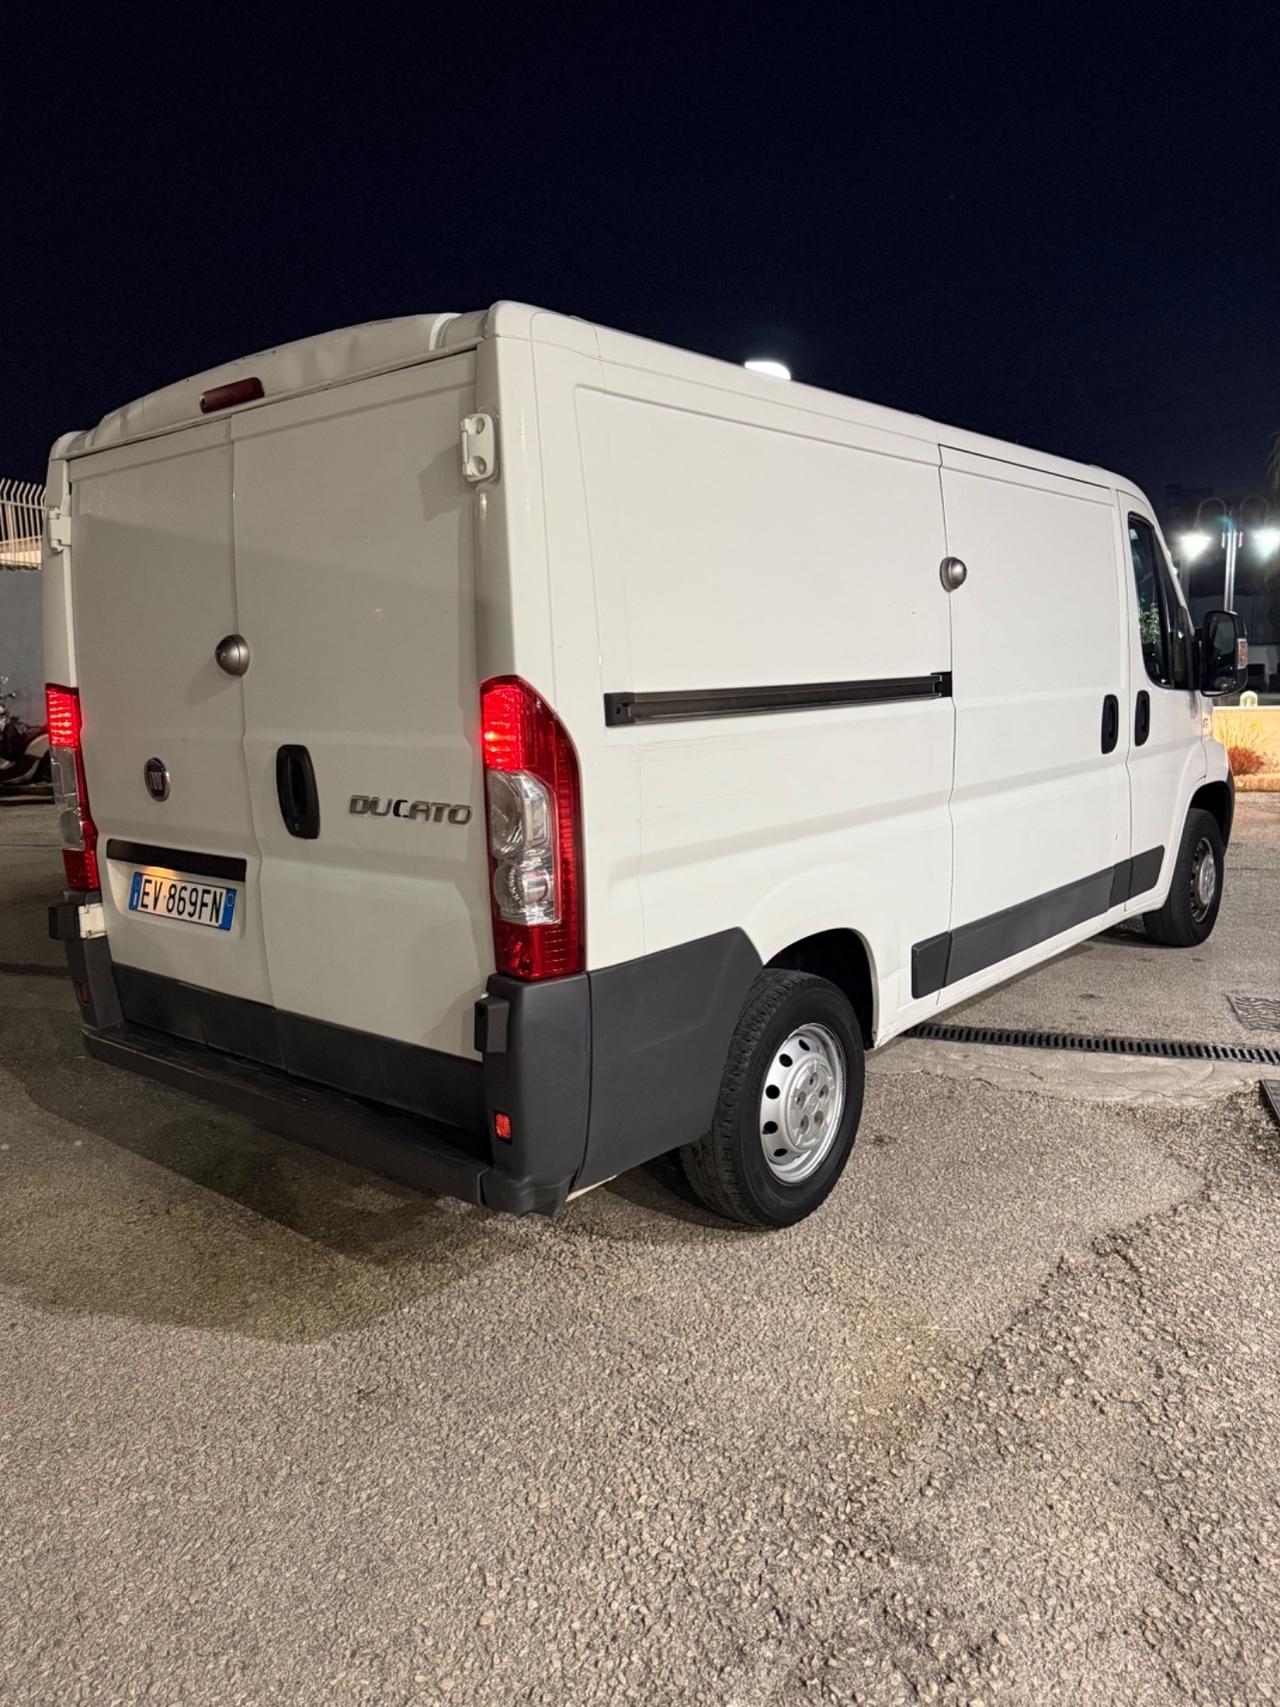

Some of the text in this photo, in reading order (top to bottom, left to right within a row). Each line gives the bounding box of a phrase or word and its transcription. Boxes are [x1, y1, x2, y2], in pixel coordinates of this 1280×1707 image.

[349, 794, 472, 825] DUCATO
[140, 878, 223, 924] EV 869FN
